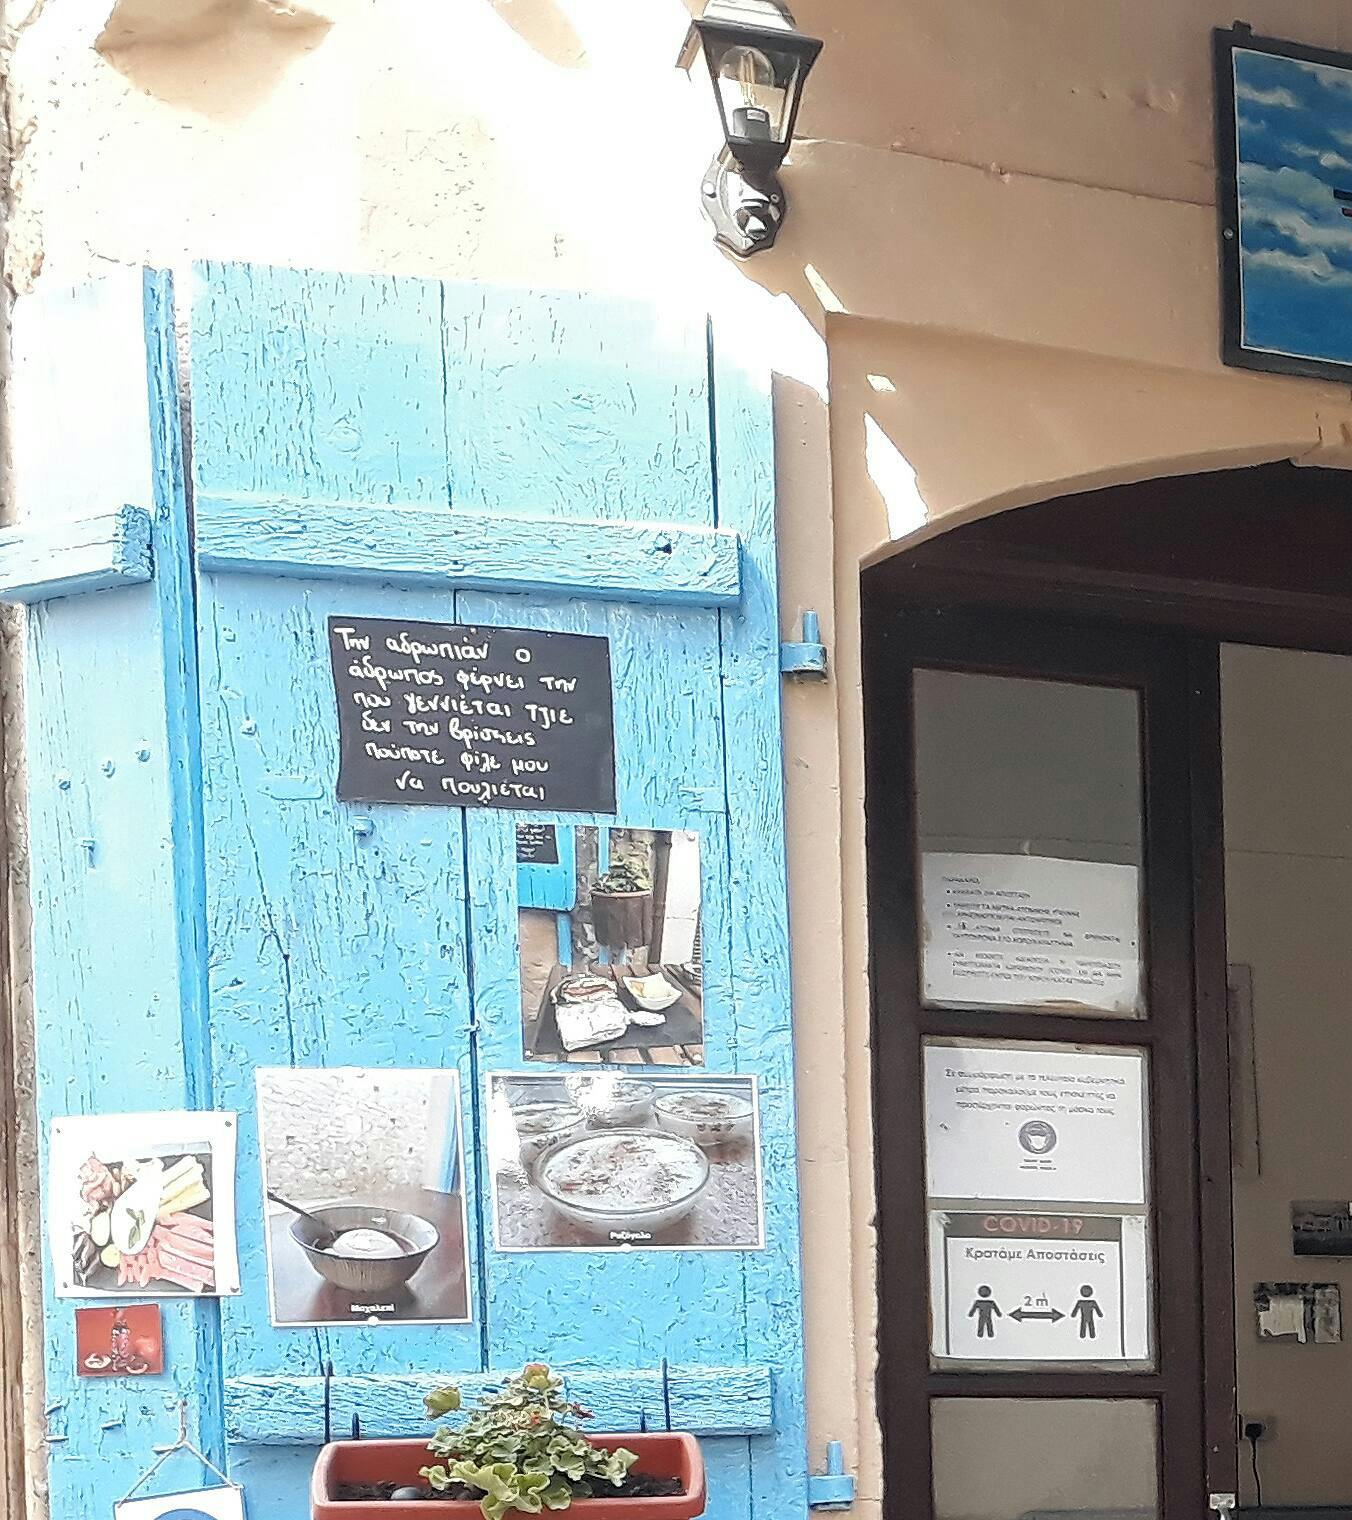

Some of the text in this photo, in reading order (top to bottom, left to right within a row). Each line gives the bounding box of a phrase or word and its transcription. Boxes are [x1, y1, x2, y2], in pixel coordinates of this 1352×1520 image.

[333, 627, 370, 651] Την
[539, 676, 577, 693] την
[353, 691, 392, 709] που
[361, 709, 391, 735] δεν
[402, 720, 439, 737] την
[511, 758, 549, 777] μου
[983, 1216, 1085, 1234] COVID-19
[965, 1246, 1106, 1264] Κρατάμε Αποστάσεις
[1023, 1295, 1033, 1307] 2
